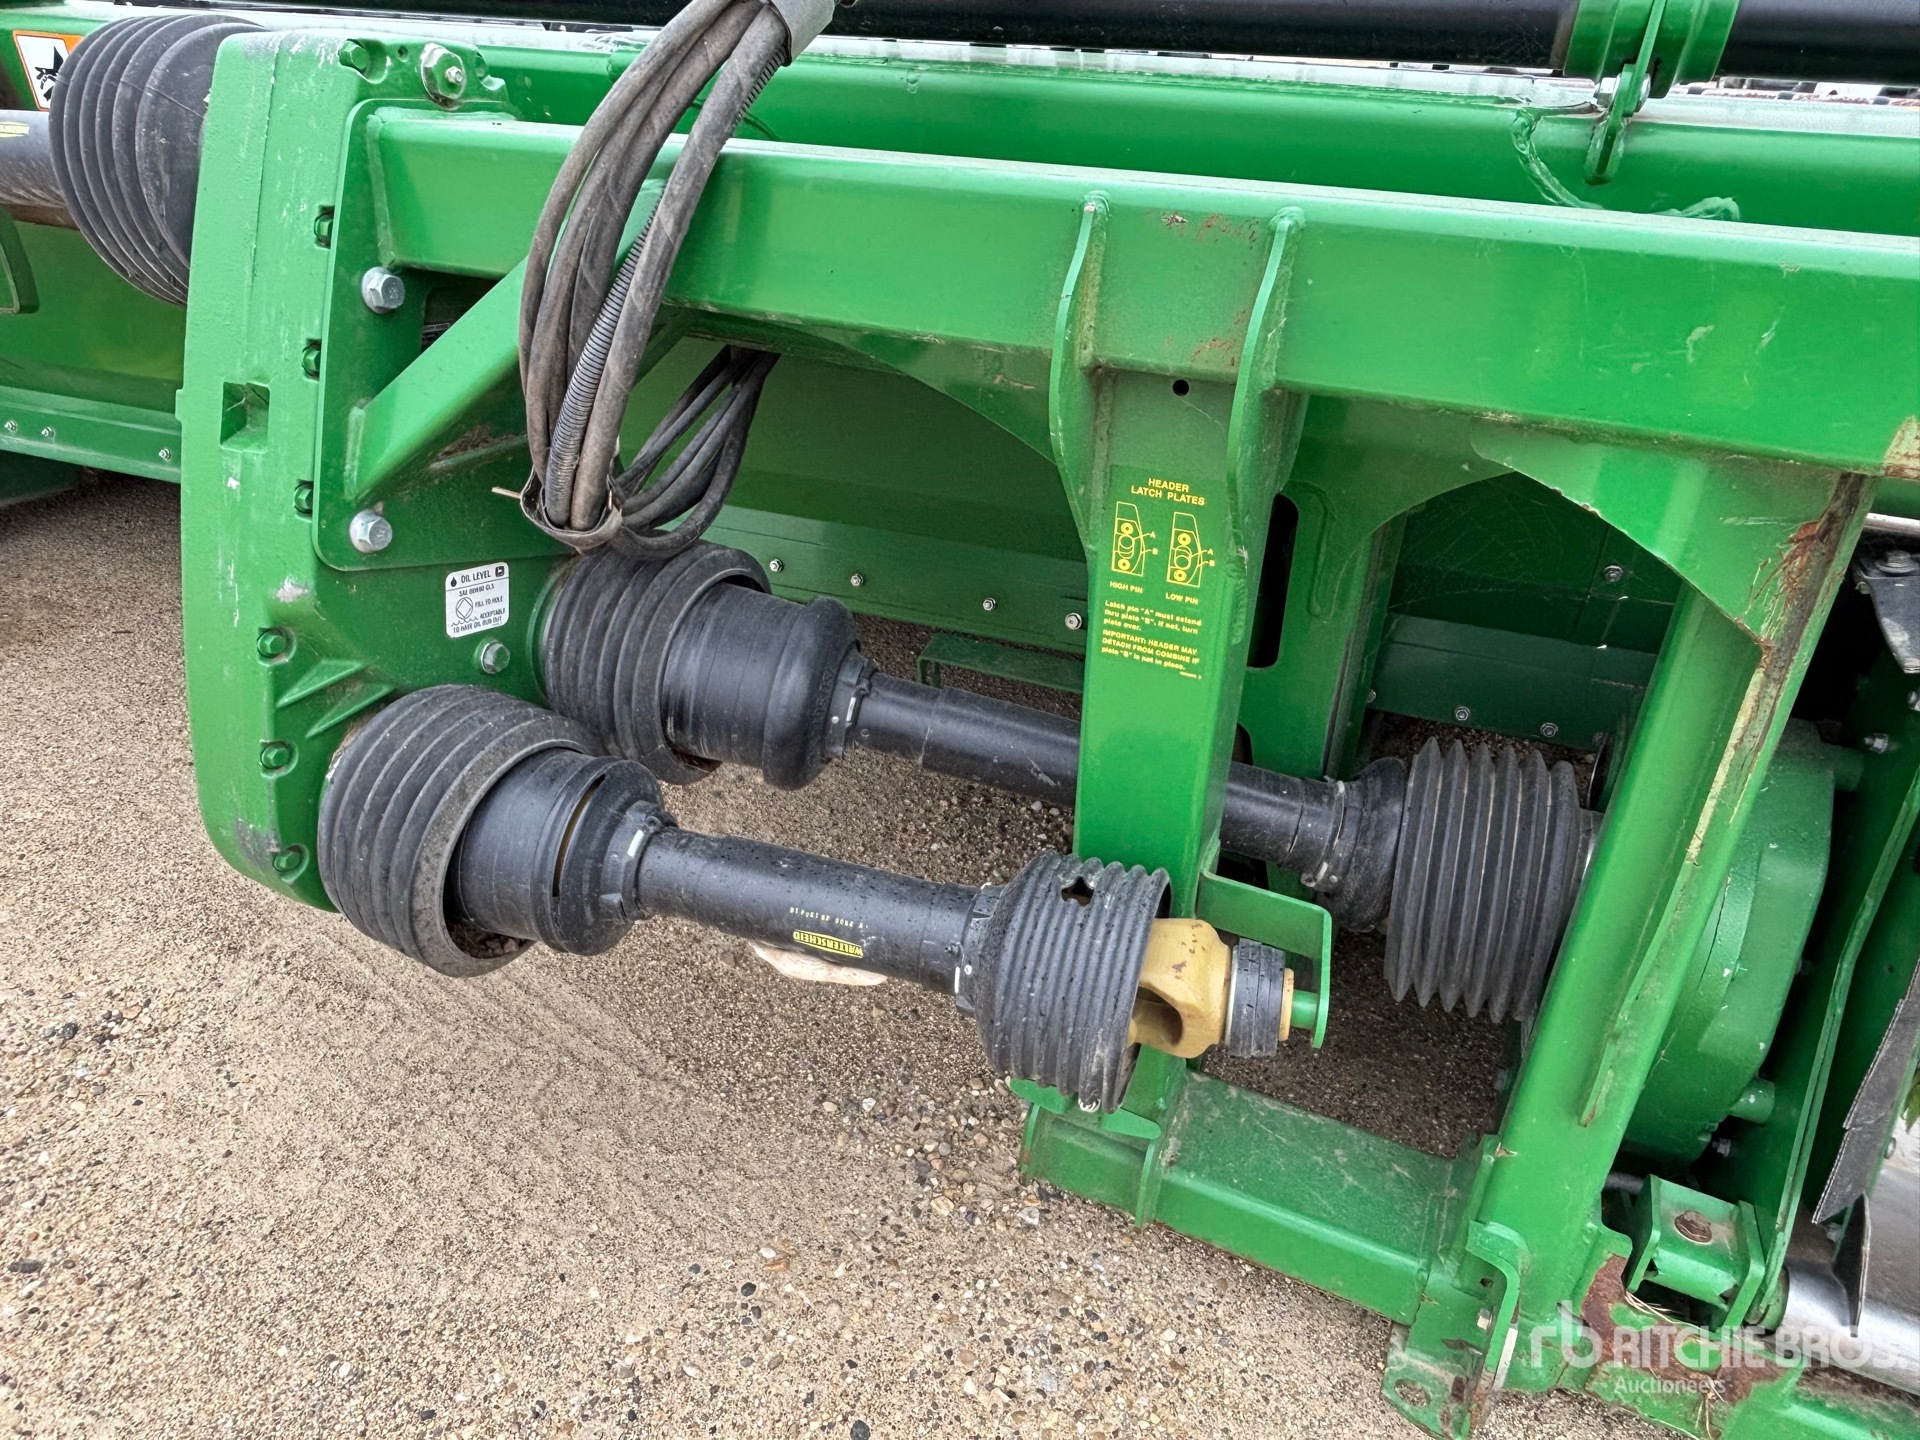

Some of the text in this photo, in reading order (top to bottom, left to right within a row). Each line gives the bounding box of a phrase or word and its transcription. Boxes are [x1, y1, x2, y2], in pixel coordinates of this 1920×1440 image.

[1148, 478, 1189, 492] HEADER
[1131, 486, 1205, 505] LATCH PLATES
[461, 570, 491, 583] OIL LEVEL
[1110, 581, 1143, 593] HIGH PIN
[1166, 593, 1198, 605] LOW PIN
[1104, 618, 1121, 626] plate
[1105, 600, 1125, 609] Latch
[1155, 611, 1174, 620] must
[1176, 616, 1201, 626] extend
[1105, 609, 1119, 617] thru
[1121, 613, 1139, 622] plate
[1182, 626, 1198, 634] turn
[1102, 638, 1131, 649] DETACH
[1133, 645, 1154, 654] FROM
[1155, 650, 1190, 663] COMBINE
[1103, 629, 1197, 655] IMPORTANT: HEADER MAY
[793, 931, 863, 956] WALTERSCHEID
